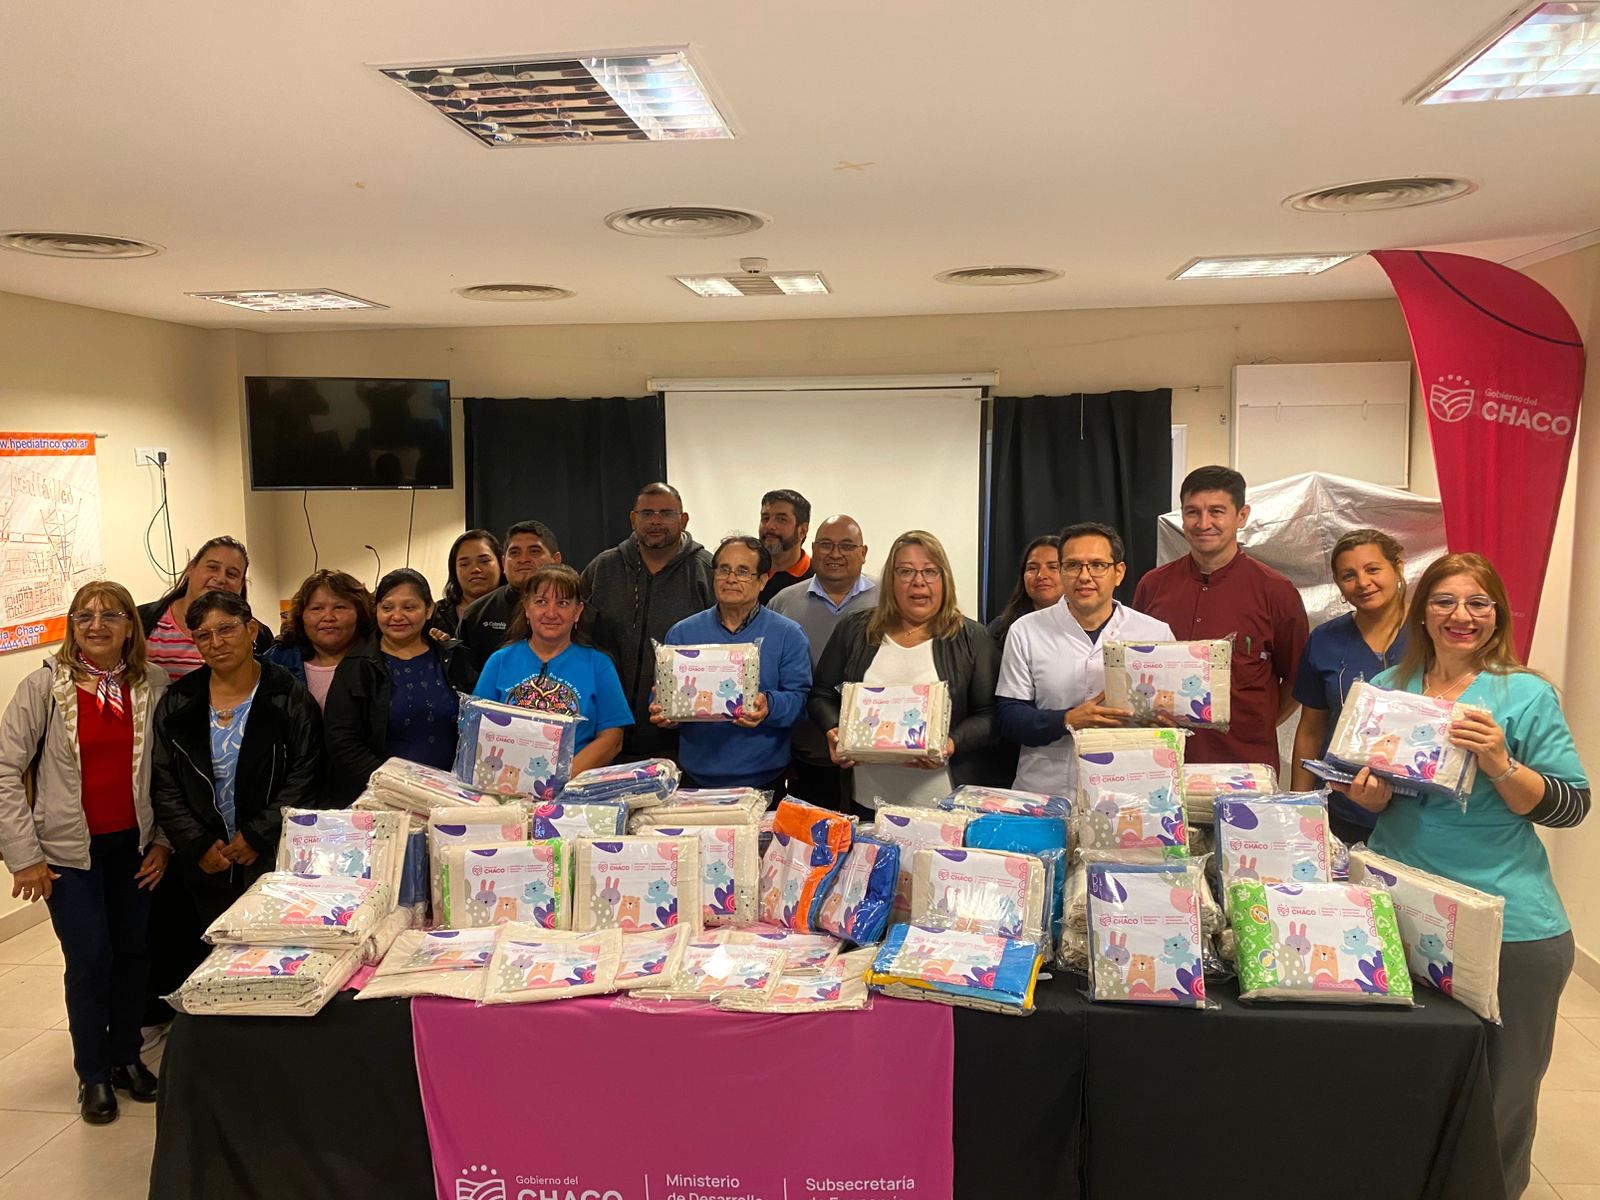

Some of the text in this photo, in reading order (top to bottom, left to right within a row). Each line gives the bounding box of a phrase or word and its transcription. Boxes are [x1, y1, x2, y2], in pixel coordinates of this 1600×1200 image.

[1484, 388, 1538, 406] Gobierno del
[1481, 400, 1572, 436] CHACO
[495, 736, 515, 744] CHACO
[950, 874, 973, 883] CHACO
[515, 1175, 579, 1185] Gobierno del
[666, 1174, 740, 1188] Ministerio
[806, 1175, 915, 1191] Subsecretaría
